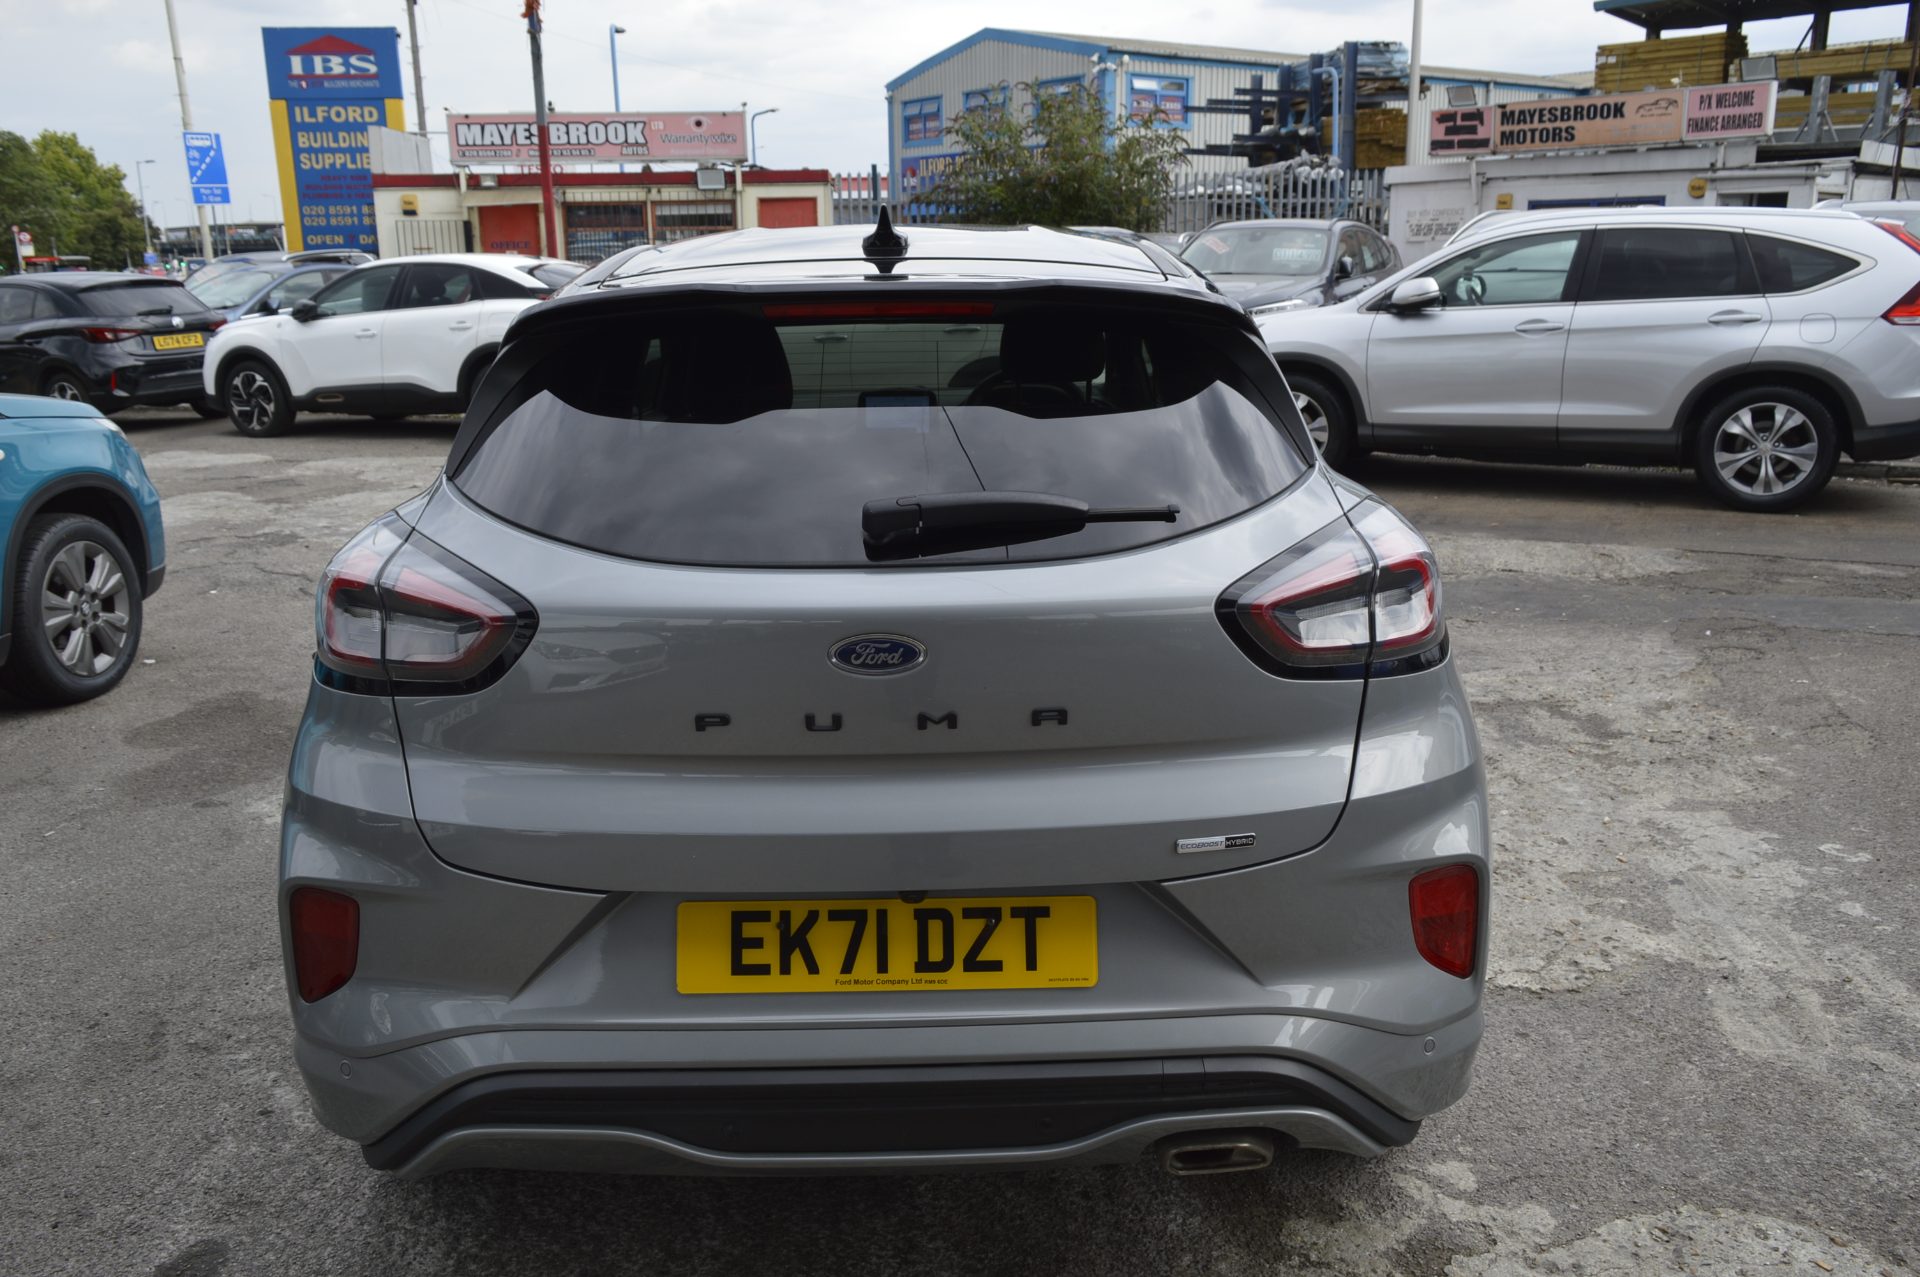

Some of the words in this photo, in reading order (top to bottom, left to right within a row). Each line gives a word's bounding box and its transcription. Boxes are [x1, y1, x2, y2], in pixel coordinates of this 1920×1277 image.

[288, 54, 378, 75] IBS
[1699, 93, 1712, 111] P/X
[1715, 90, 1755, 109] WELCOME
[294, 105, 379, 123] ILFORD
[1500, 102, 1626, 126] MAYESBROOK
[1687, 115, 1719, 133] FINANCE
[1720, 112, 1764, 130] ARRANGED
[297, 131, 369, 148] BUILDIN
[1500, 126, 1576, 146] MOTORS
[621, 146, 649, 156] AUTOS
[300, 153, 371, 169] SUPPLIE
[518, 164, 564, 174] TESO
[303, 205, 325, 215] 020
[304, 216, 326, 226] 020
[307, 234, 344, 245] OPEN
[850, 642, 903, 666] Ford
[1180, 840, 1225, 850] ECOBOOST
[1225, 837, 1254, 847] HYBRID
[730, 908, 889, 977] EK71
[913, 906, 1051, 974] DZT
[835, 978, 852, 986] Ford
[875, 978, 909, 986] Company
[911, 977, 923, 985] Ltd
